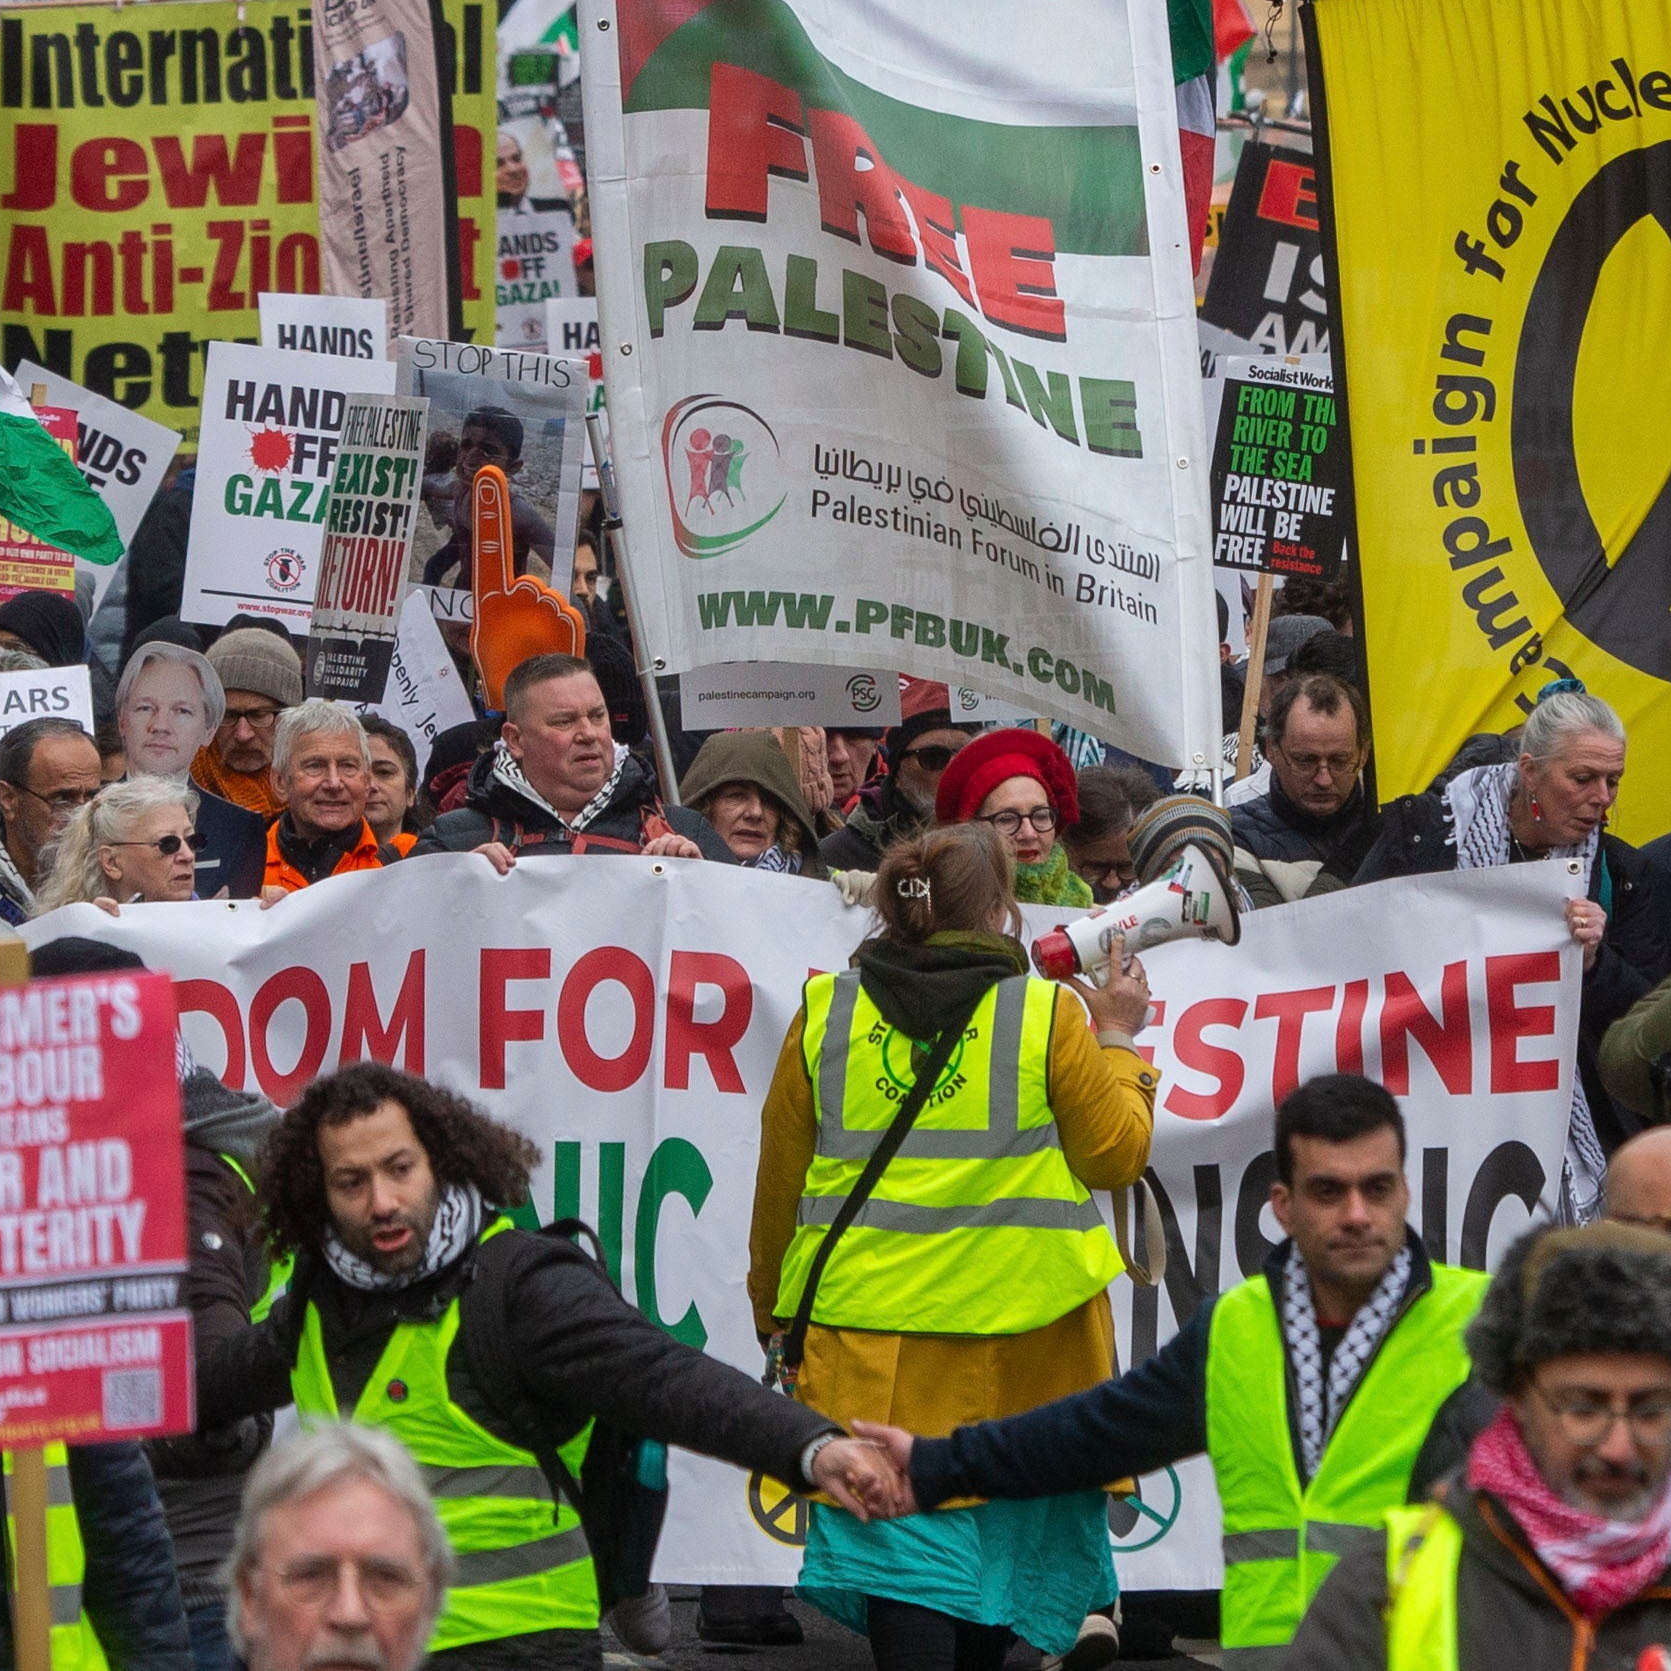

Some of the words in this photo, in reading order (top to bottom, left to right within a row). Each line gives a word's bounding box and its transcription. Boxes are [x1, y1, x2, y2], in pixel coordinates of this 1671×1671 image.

[704, 60, 1067, 344] FREE
[1452, 158, 1539, 286] for
[497, 231, 560, 259] ANDS
[495, 279, 561, 308] GAZA!
[277, 323, 374, 361] HANDS
[643, 239, 1144, 460] PALESTINE
[411, 340, 501, 381] STOP
[505, 350, 574, 391] THIS
[1248, 364, 1298, 385] Socialist
[1297, 369, 1334, 390] Work
[224, 379, 347, 432] HAND
[1237, 384, 1296, 419] FROM
[342, 404, 366, 447] FREE
[363, 405, 424, 452] PALESTINE
[1232, 414, 1293, 451] RIVER
[1299, 422, 1329, 455] TO
[333, 453, 418, 500] EXIST!
[1229, 442, 1268, 476] THE
[1271, 450, 1314, 484] SEA
[1222, 472, 1336, 518] PALESTINE
[328, 498, 412, 539] RESIST!
[1218, 502, 1268, 538] WILL
[1272, 510, 1304, 543] BE
[810, 488, 964, 552] Palestinian
[970, 531, 1042, 587] Forum
[1044, 563, 1066, 596] in
[1075, 572, 1159, 627] Britain
[1213, 531, 1265, 567] FREE
[1270, 555, 1324, 576] resistance
[1271, 539, 1298, 558] Back
[1297, 542, 1316, 560] the
[265, 577, 302, 593] COALITION
[315, 535, 407, 618] RETURN!
[696, 589, 1117, 716] WWW.PFBUK.COM
[697, 689, 816, 703] palestinecampaign.org
[851, 685, 875, 703] PSC
[479, 945, 753, 1095] FOR
[874, 1073, 968, 1109] COATION
[36, 1138, 132, 1207] AND
[11, 1285, 110, 1322] WORKERS'
[112, 1277, 179, 1313] PARTY
[28, 1326, 163, 1376] SOCIALISM
